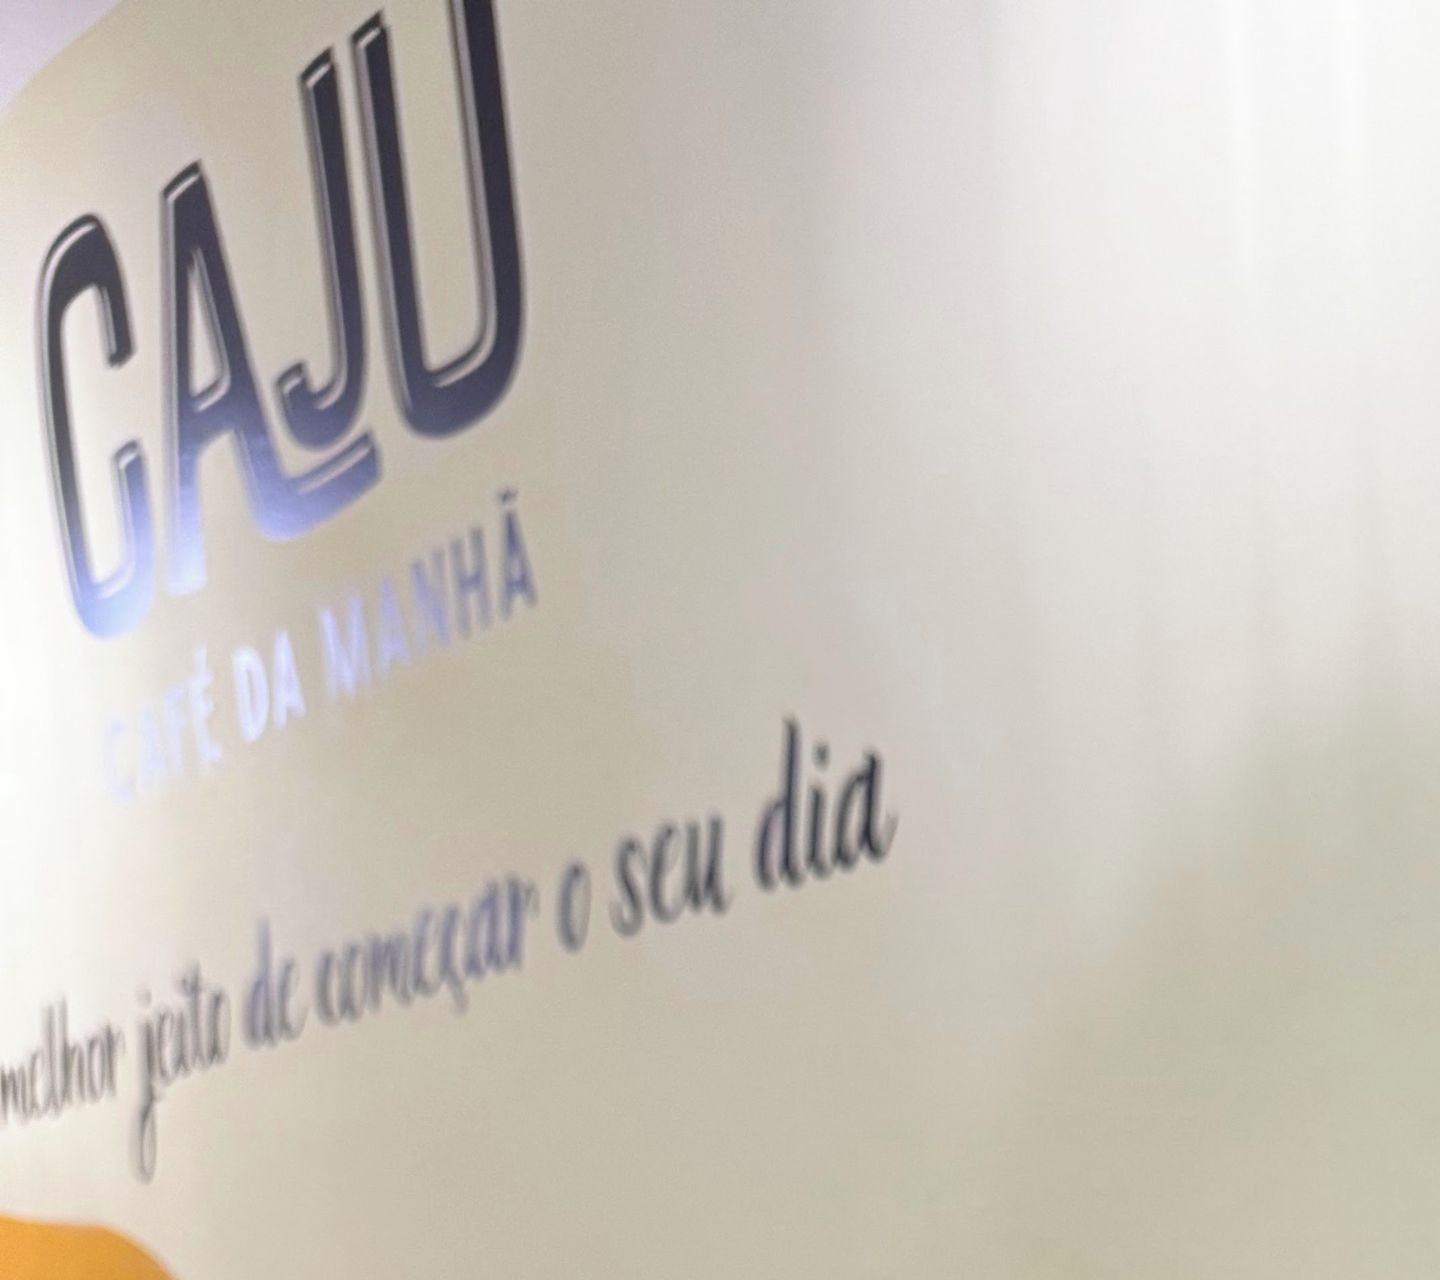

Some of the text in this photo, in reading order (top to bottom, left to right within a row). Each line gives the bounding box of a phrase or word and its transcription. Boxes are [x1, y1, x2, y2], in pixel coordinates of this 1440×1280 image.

[36, 0, 527, 640] CAJU
[232, 630, 307, 744] DA
[319, 486, 540, 702] MANHÃ
[0, 714, 897, 1184] melhor jeito de começar o seu dia
